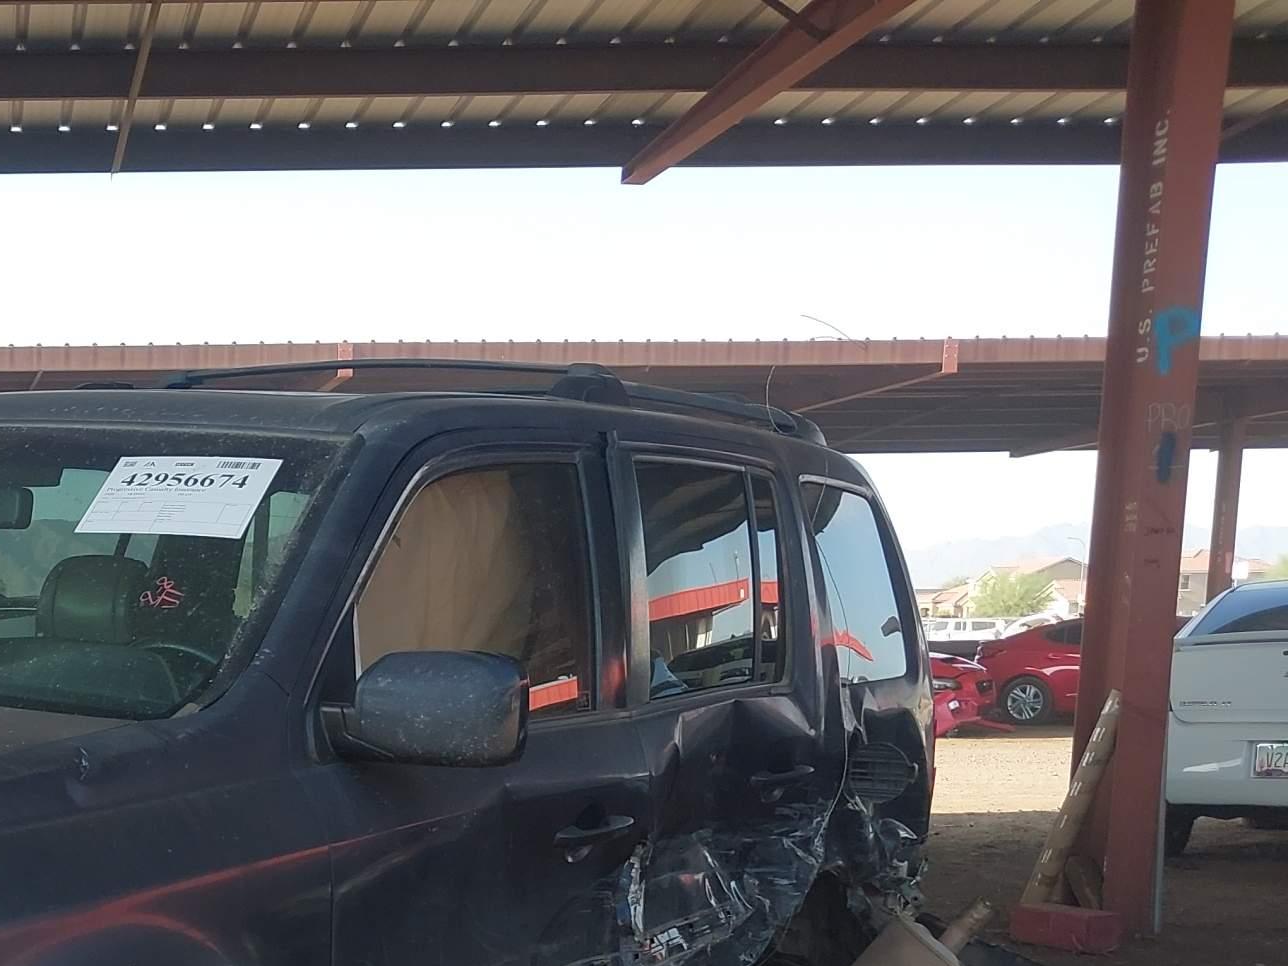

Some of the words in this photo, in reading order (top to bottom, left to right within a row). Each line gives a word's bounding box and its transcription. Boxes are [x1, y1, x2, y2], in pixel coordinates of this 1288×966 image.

[1151, 109, 1172, 165] INC.
[1142, 181, 1164, 293] PREFAB
[1136, 308, 1154, 363] U.S.
[1153, 305, 1199, 376] P
[121, 471, 249, 489] 42956674
